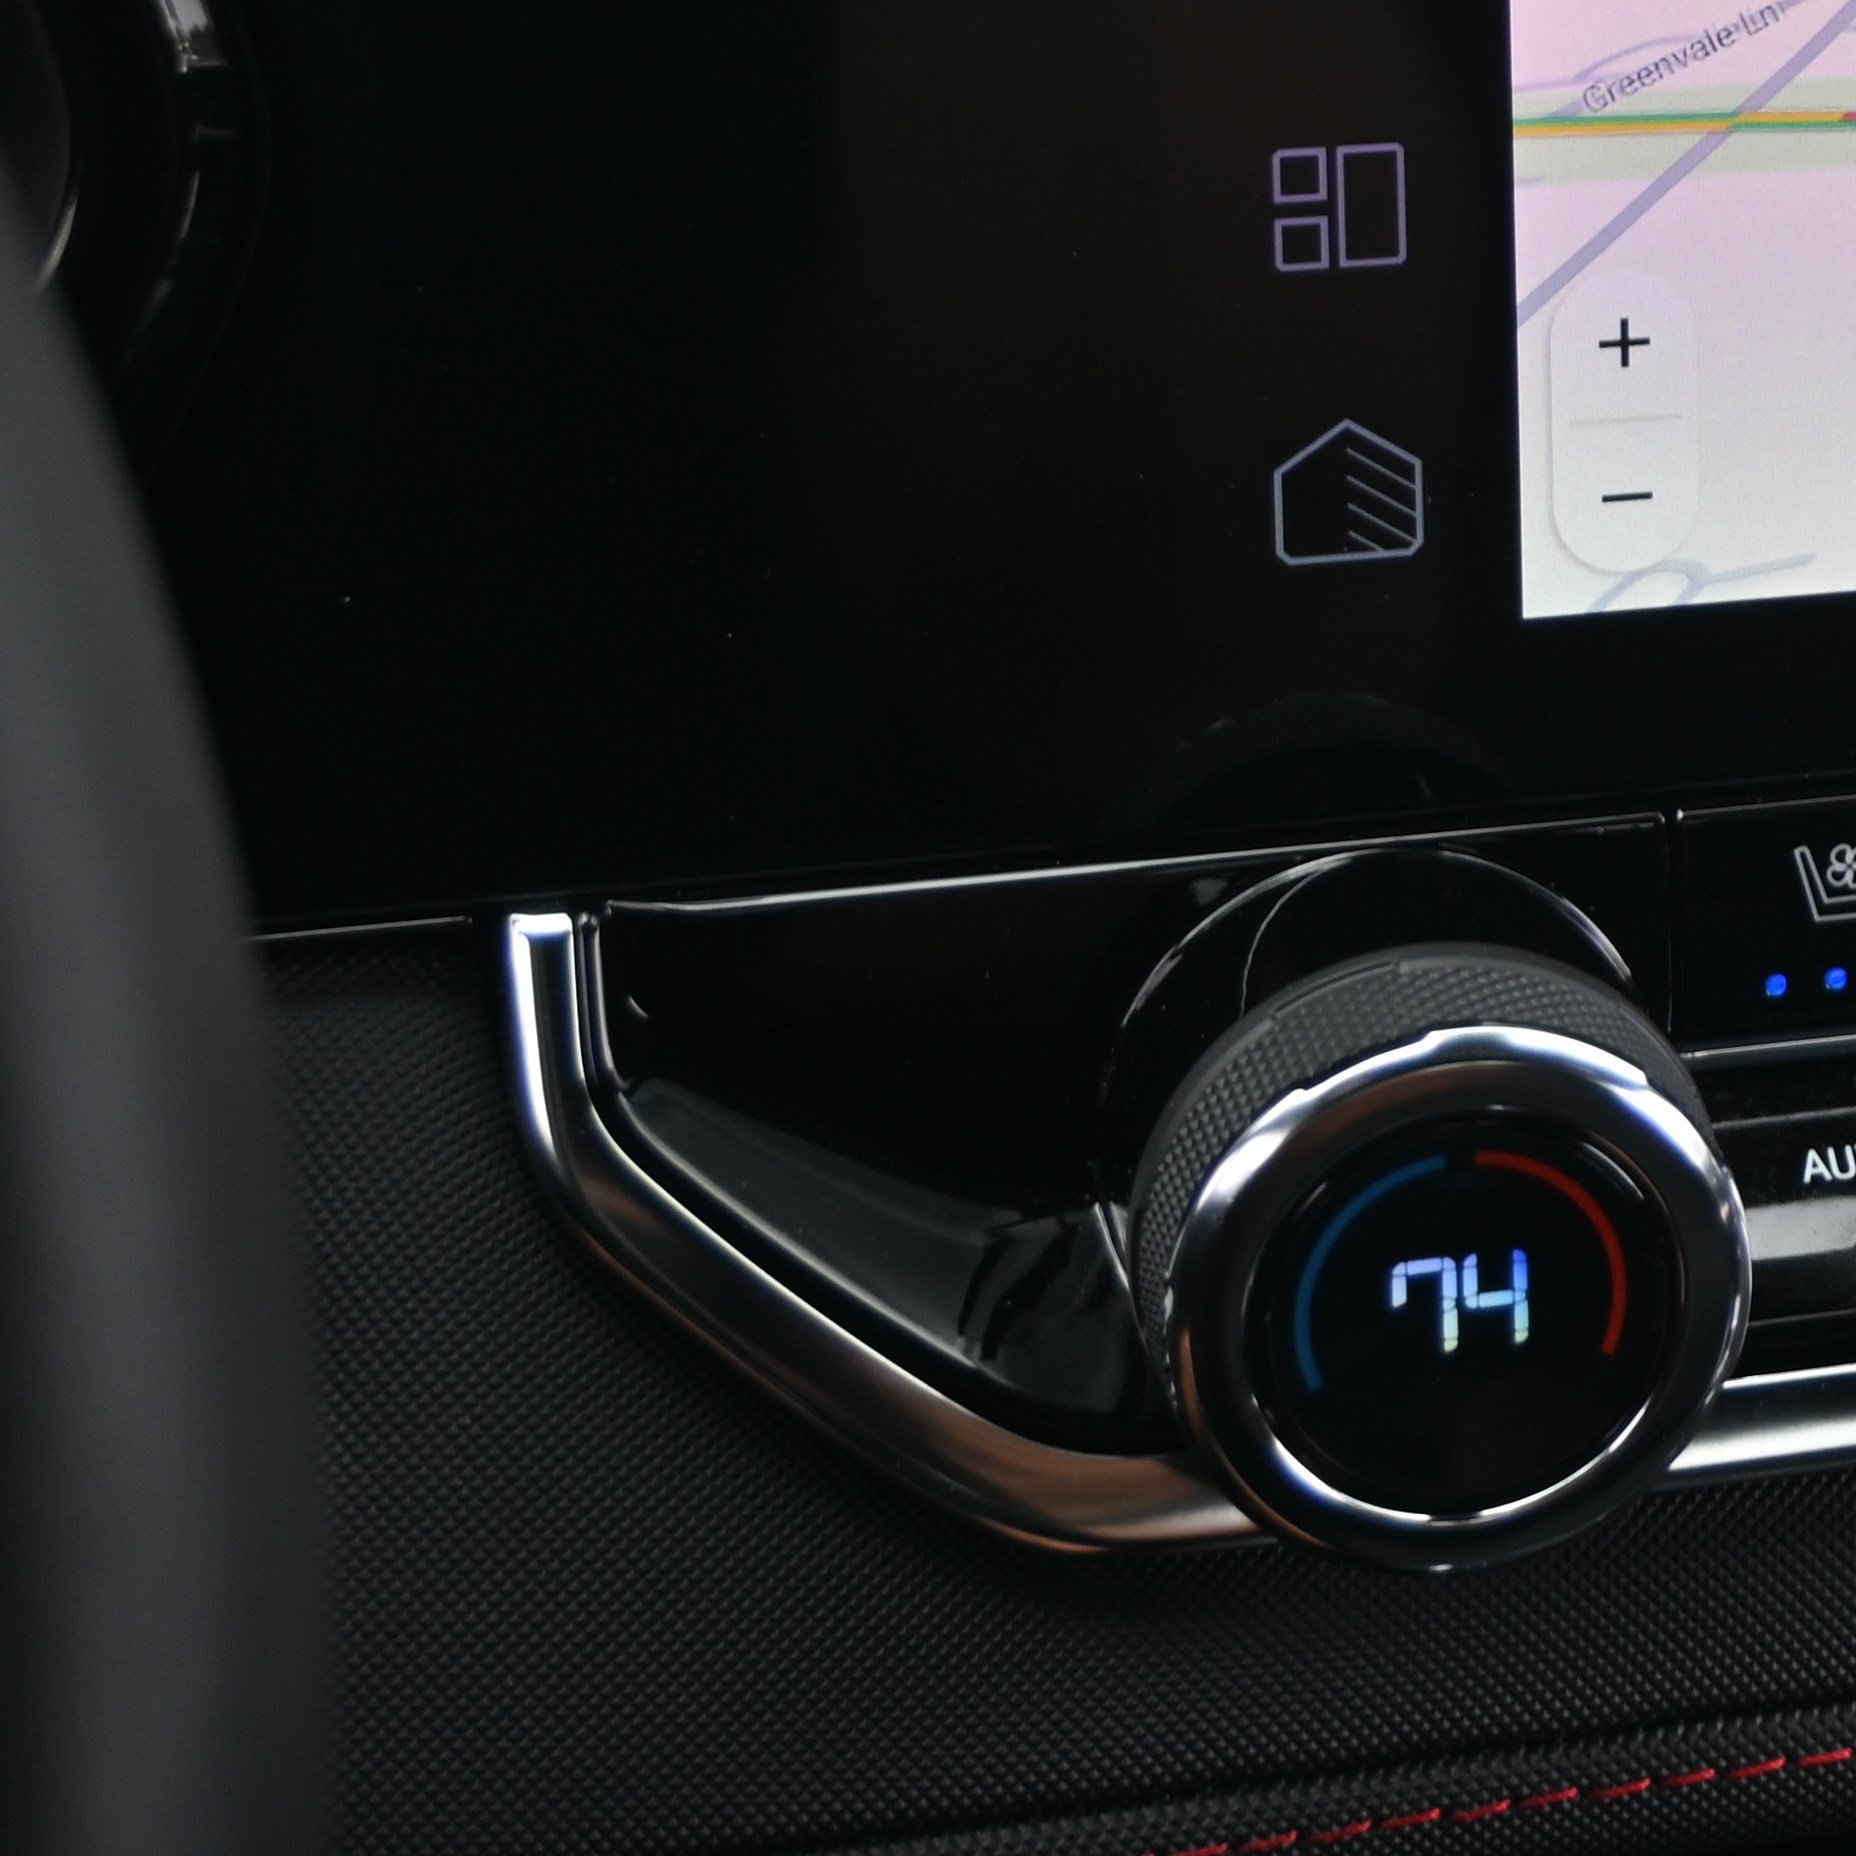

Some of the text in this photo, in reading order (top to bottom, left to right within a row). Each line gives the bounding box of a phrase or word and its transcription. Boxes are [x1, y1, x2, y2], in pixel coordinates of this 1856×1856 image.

[1581, 0, 1783, 114] Greenvale Ln
[1390, 1247, 1530, 1353] 74
